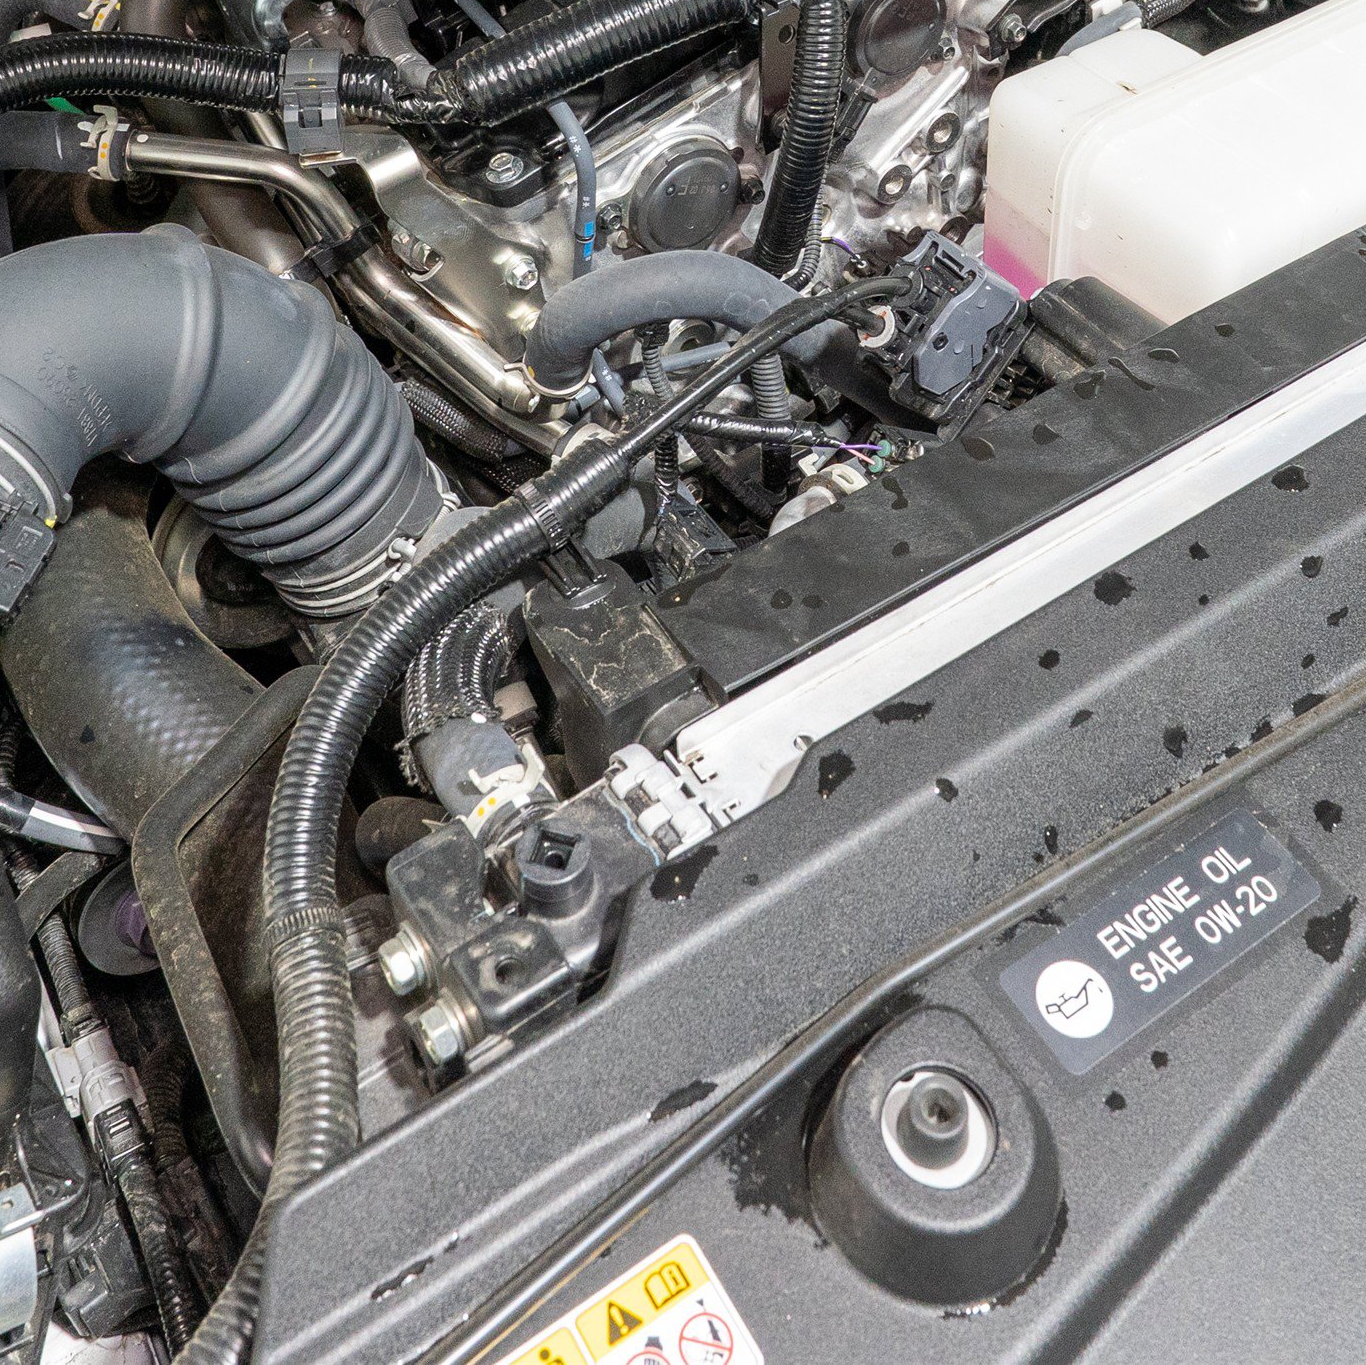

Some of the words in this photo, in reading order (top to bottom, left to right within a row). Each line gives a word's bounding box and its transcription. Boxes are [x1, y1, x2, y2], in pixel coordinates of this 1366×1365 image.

[1096, 875, 1201, 961] ENGINE
[1201, 845, 1253, 885] OIL
[1128, 935, 1195, 994] SAE
[1194, 874, 1279, 946] 0W-20
